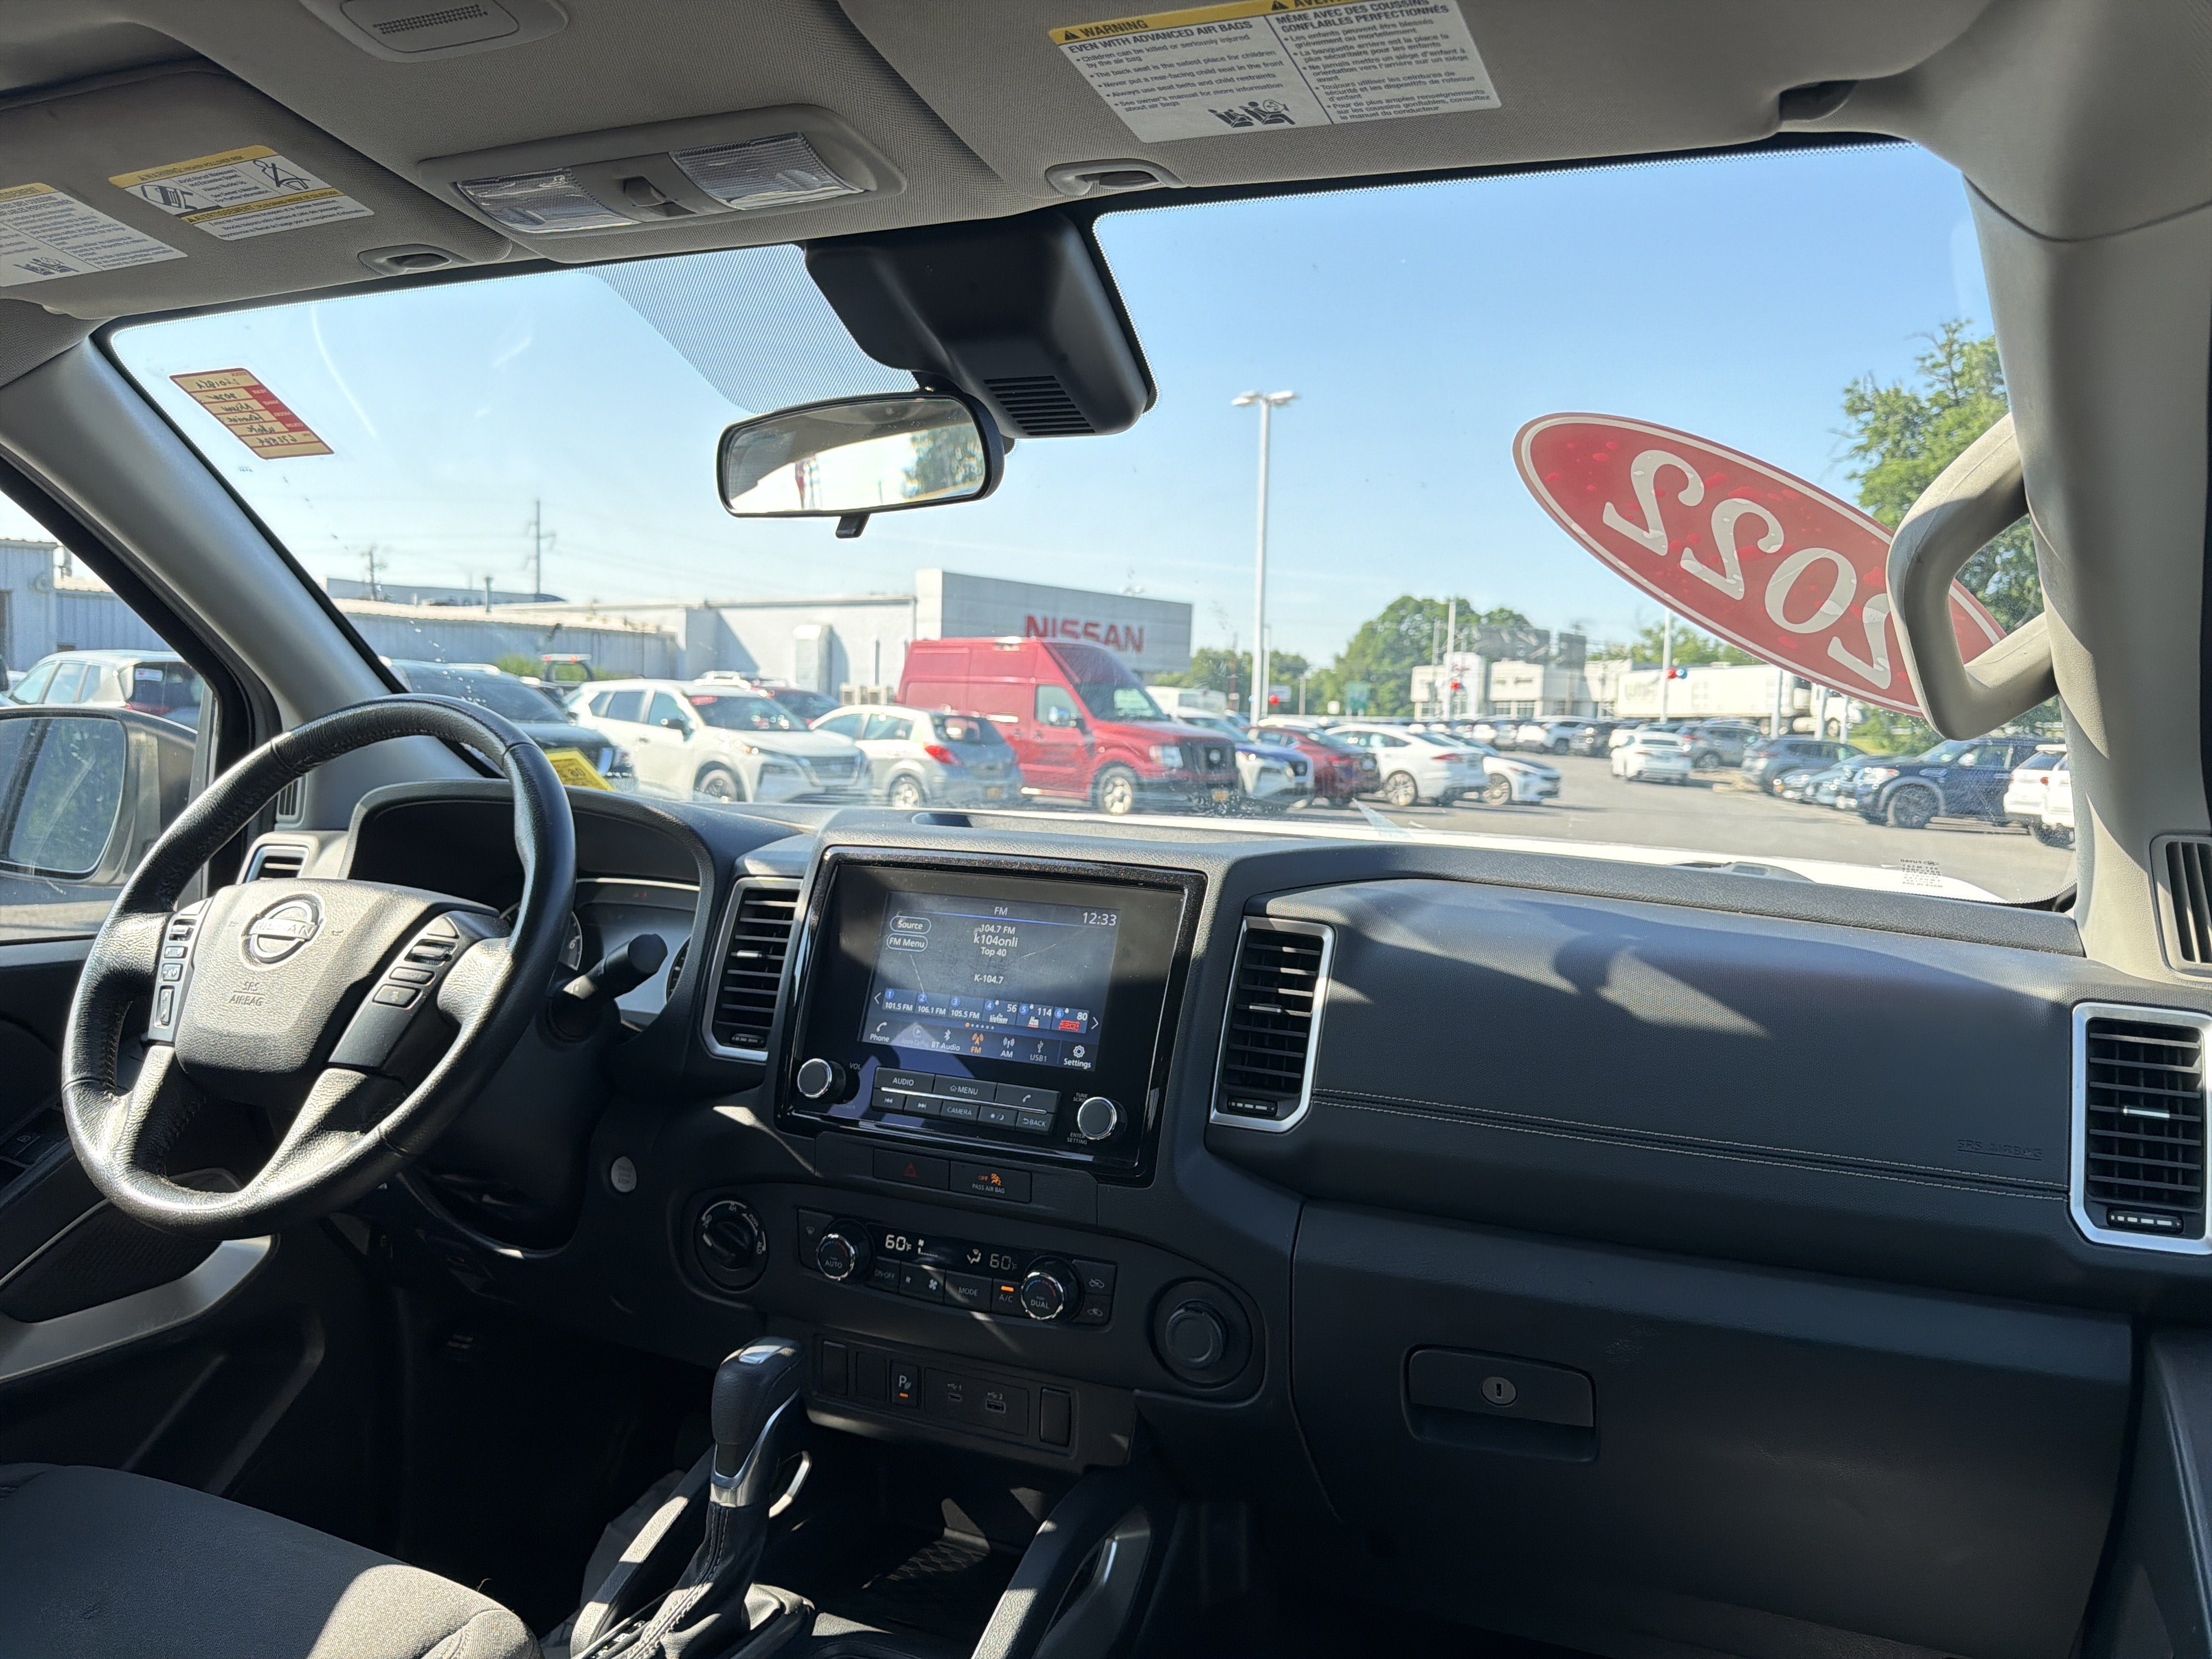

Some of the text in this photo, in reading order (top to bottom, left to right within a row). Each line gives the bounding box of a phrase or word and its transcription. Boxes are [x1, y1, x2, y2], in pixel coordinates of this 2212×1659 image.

[1276, 13, 1310, 24] MÊME
[1313, 8, 1342, 19] AVEC
[1344, 5, 1368, 14] DES
[1282, 4, 1448, 32] GONFLABLES PERFECTIONNÉS
[1080, 20, 1147, 36] WARNING
[1068, 21, 1252, 53] EVEN WITH ADVANCED AIR BAGS
[1081, 53, 1115, 61] Children
[1180, 39, 1217, 48] seriously
[1219, 34, 1250, 43] injured
[1241, 50, 1276, 59] children
[1150, 71, 1195, 81] rear-facing
[1235, 83, 1283, 92] information
[1025, 614, 1145, 653] NISSAN
[994, 906, 1008, 916] FM
[1082, 911, 1118, 927] 12:33
[897, 919, 924, 930] Source
[980, 924, 1015, 935] 104.7 FM
[889, 937, 925, 948] FM Menu
[973, 933, 1019, 947] k104onli
[980, 947, 1007, 957] Top 40
[973, 973, 1005, 984] K-104.7
[884, 1002, 913, 1012] 101.5 FM
[917, 1006, 947, 1015] 106.1 FM
[1006, 1003, 1018, 1013] 56
[1037, 1007, 1053, 1017] 114
[951, 1009, 980, 1019] 105.5 FM
[1076, 1012, 1088, 1021] 80
[870, 1033, 890, 1042] Phone
[940, 1042, 961, 1051] Audio
[1000, 1050, 1014, 1058] AM
[1029, 1053, 1048, 1063] USB1
[1063, 1058, 1092, 1069] Settings
[892, 1076, 915, 1086] AUDIO
[957, 1086, 979, 1096] MENU
[947, 1106, 972, 1116] CAMERA
[1029, 1119, 1047, 1127] BACK
[994, 1186, 1006, 1194] BAG
[824, 1260, 843, 1269] AUTO
[958, 1286, 978, 1296] MODE
[998, 1294, 1014, 1303] A/C
[1030, 1299, 1050, 1310] DUAL
